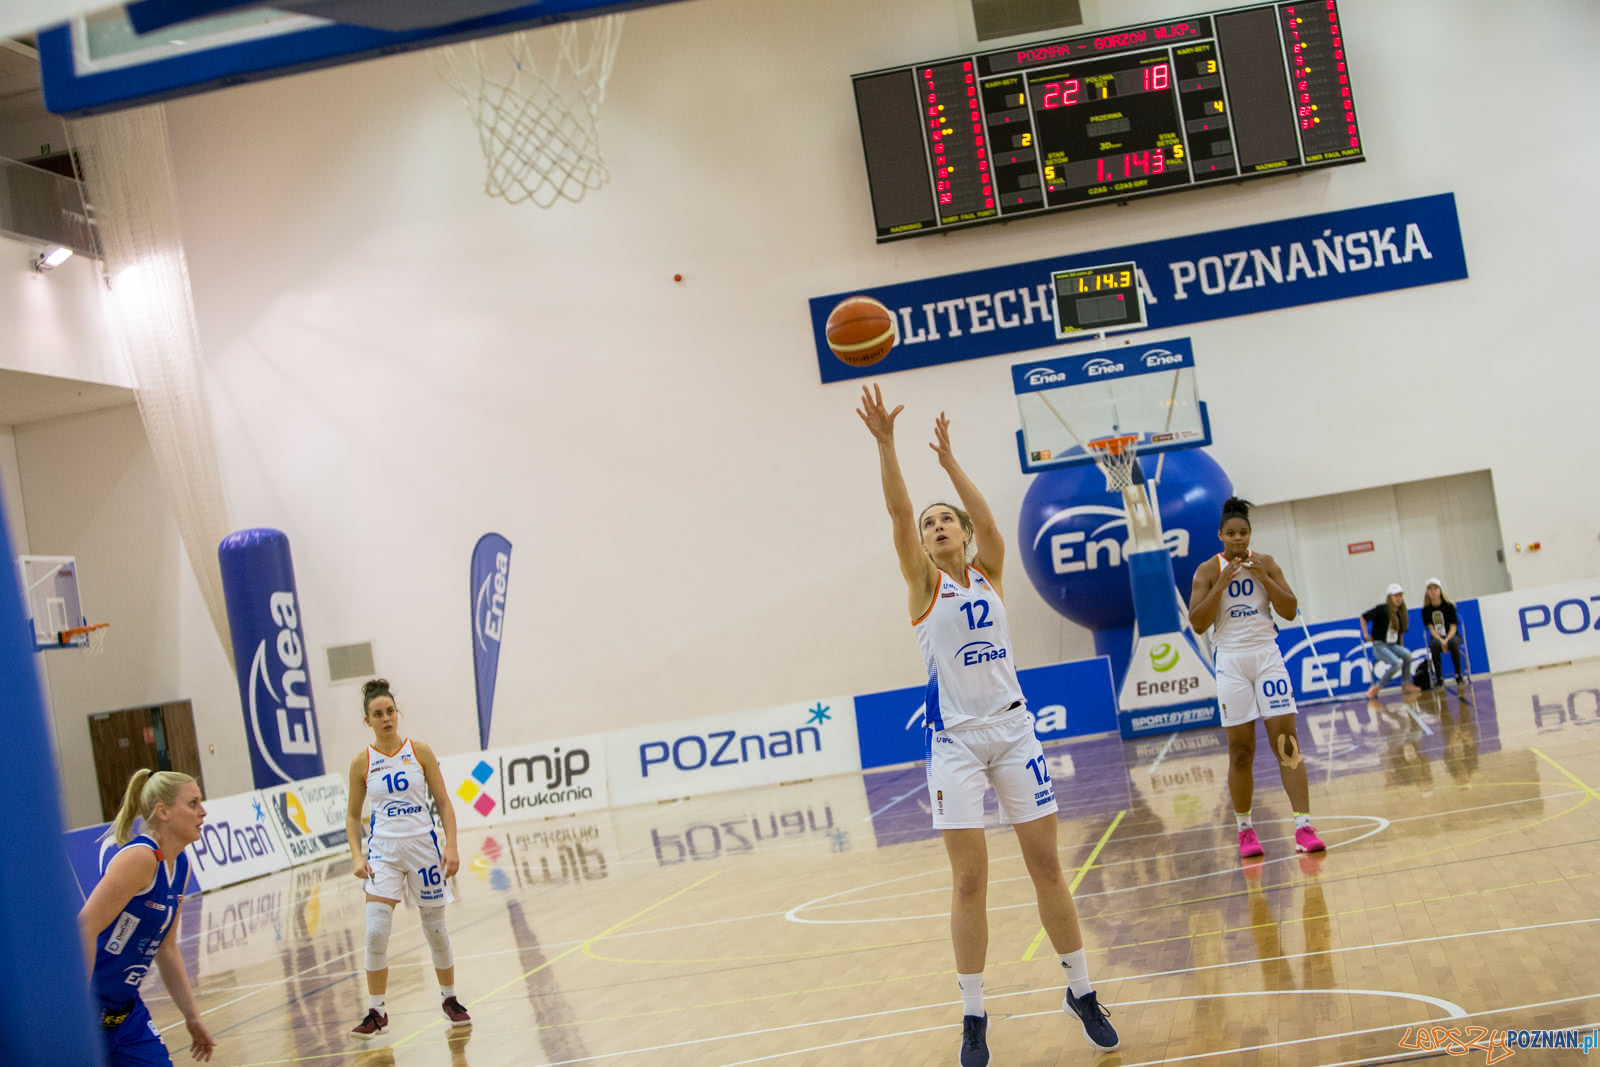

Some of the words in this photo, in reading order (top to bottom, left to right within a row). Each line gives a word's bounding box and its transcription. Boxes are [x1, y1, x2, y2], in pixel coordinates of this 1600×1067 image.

[1017, 44, 1070, 64] POZNAN
[1094, 30, 1147, 49] GORZOW
[1144, 64, 1169, 90] 18
[1207, 60, 1216, 73] 3
[1043, 79, 1079, 109] 22
[1213, 101, 1223, 112] 4
[1021, 133, 1032, 147] 2
[1173, 144, 1184, 158] 5
[1044, 166, 1055, 180] 5
[1170, 222, 1432, 301] POZNAŃSKA
[1088, 363, 1124, 376] Enea
[1146, 354, 1183, 367] Enea
[1030, 372, 1066, 386] Enea
[485, 551, 509, 642] Enea
[960, 599, 993, 630] 12
[964, 648, 1006, 666] Enea
[270, 592, 317, 755] Enea
[1137, 677, 1199, 697] Energa
[1263, 679, 1288, 698] 00
[507, 747, 590, 789] mjp
[1026, 754, 1050, 785] 12
[382, 771, 409, 793] 16
[510, 785, 593, 810] drukarnia
[387, 804, 422, 817] Enea
[417, 865, 441, 887] 16
